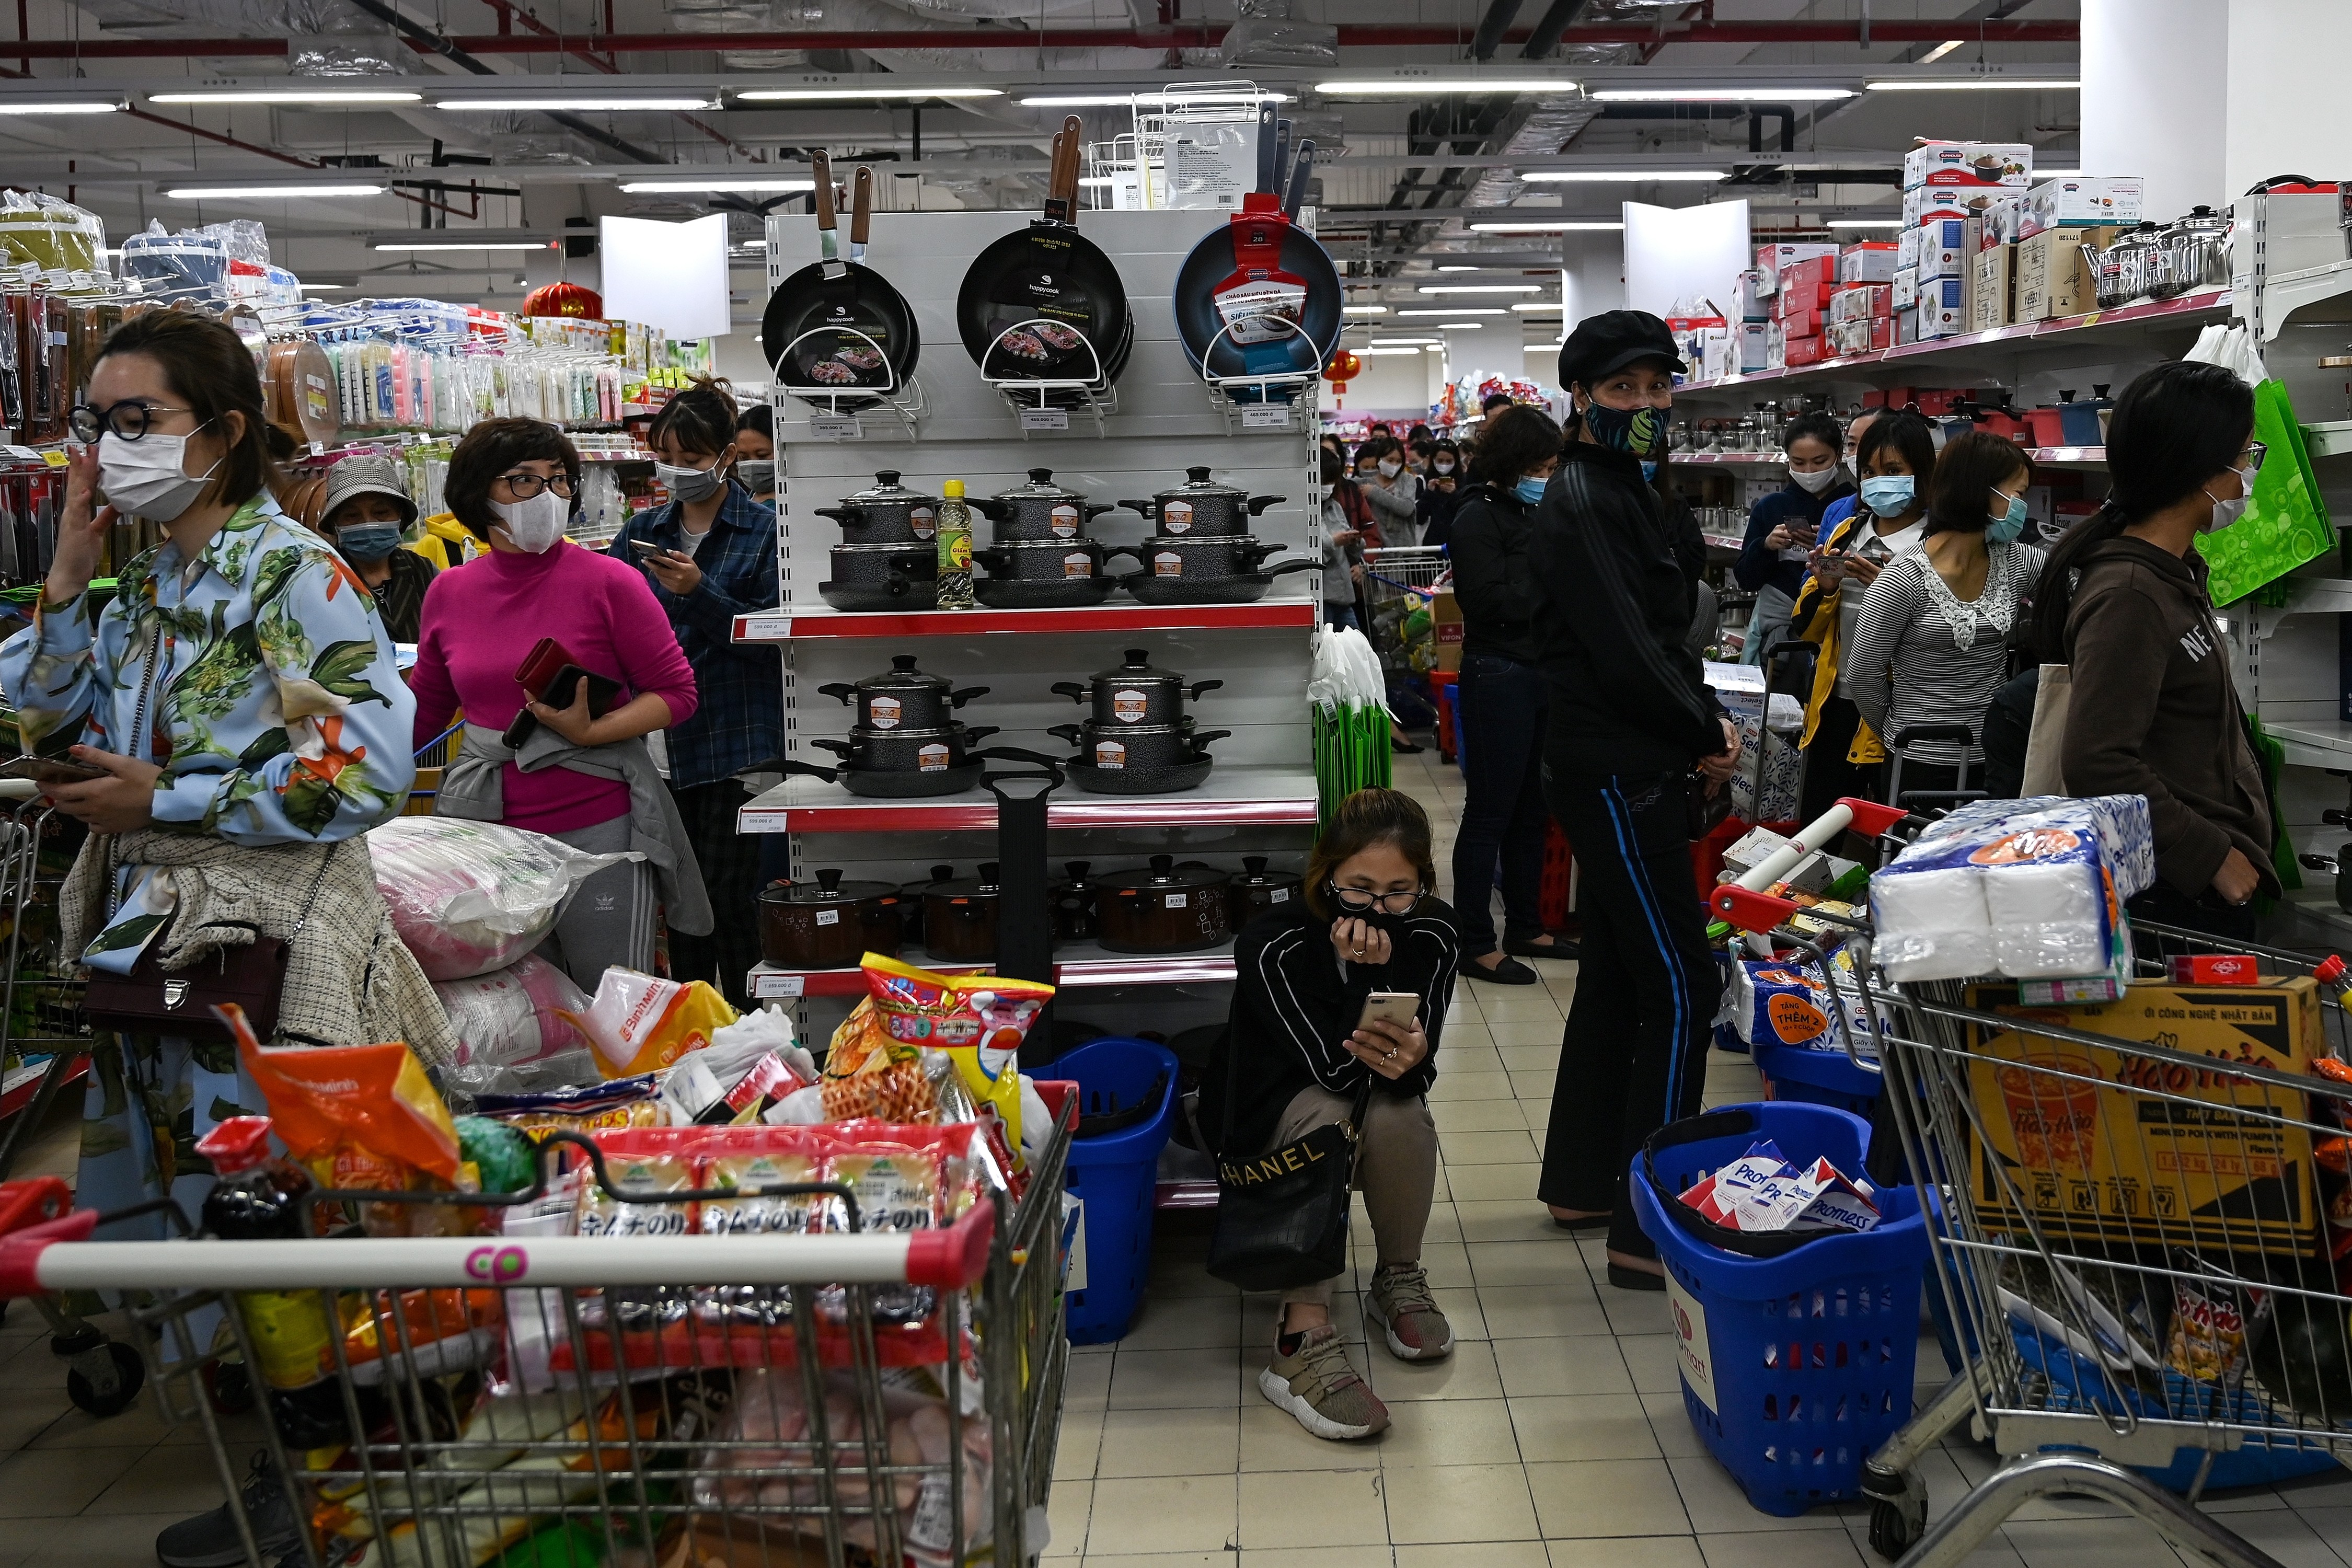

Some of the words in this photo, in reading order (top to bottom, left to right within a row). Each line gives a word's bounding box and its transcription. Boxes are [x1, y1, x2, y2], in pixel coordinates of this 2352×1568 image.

[1780, 1002, 1800, 1011] TẶNG
[1777, 1012, 1809, 1024] THÊM
[1812, 1017, 1819, 1026] 2
[2159, 1007, 2185, 1019] CÔNG
[2189, 1007, 2216, 1021] NGHỆ
[2221, 1008, 2247, 1021] NHẬT
[2251, 1008, 2273, 1021] BẢN
[1220, 1143, 1325, 1186] CHANEL
